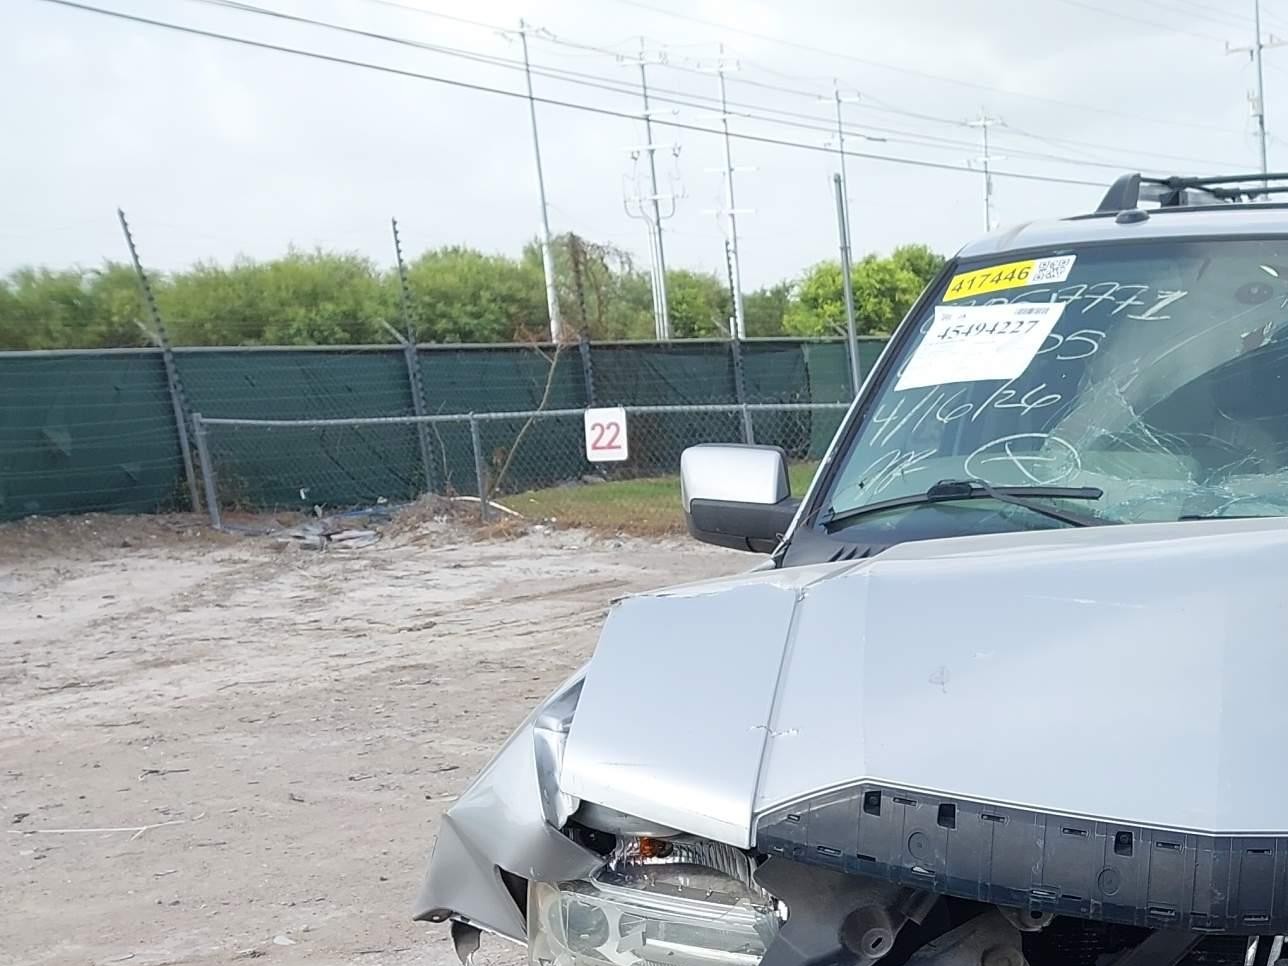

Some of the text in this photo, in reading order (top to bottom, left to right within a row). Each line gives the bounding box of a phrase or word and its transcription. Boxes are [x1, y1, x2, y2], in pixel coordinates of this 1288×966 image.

[951, 265, 1032, 293] 417446
[937, 320, 1039, 340] 45494227
[869, 378, 1062, 447] 4/16/26
[591, 421, 622, 451] 22
